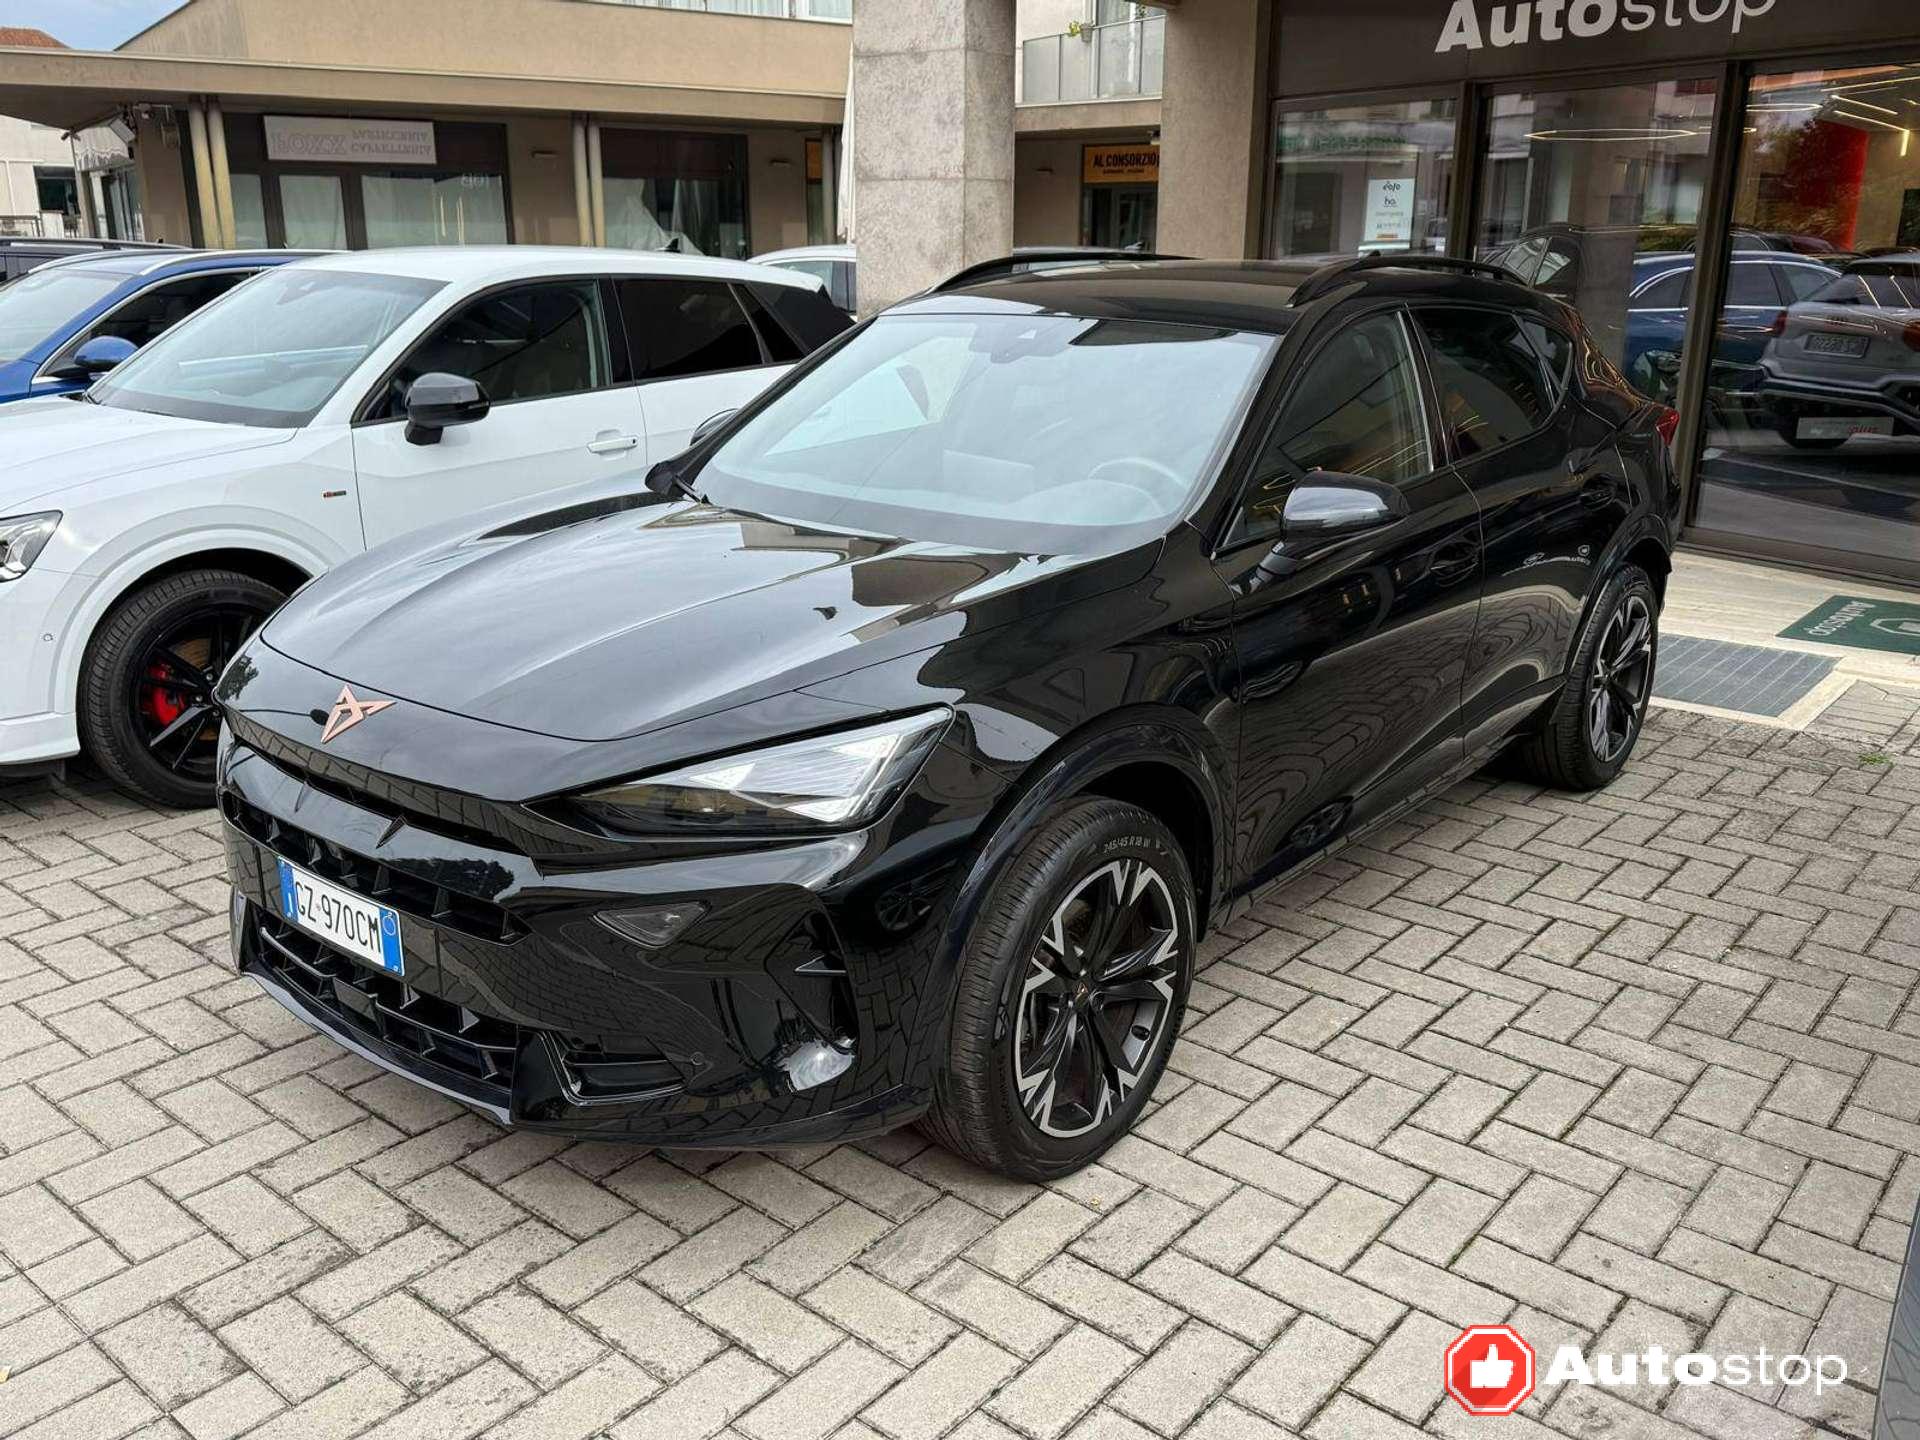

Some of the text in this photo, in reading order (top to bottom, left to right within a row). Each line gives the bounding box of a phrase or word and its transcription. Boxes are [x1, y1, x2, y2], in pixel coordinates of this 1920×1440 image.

[1434, 0, 1777, 53] Autostop
[1092, 154, 1104, 168] AL
[321, 894, 381, 954] 970CM
